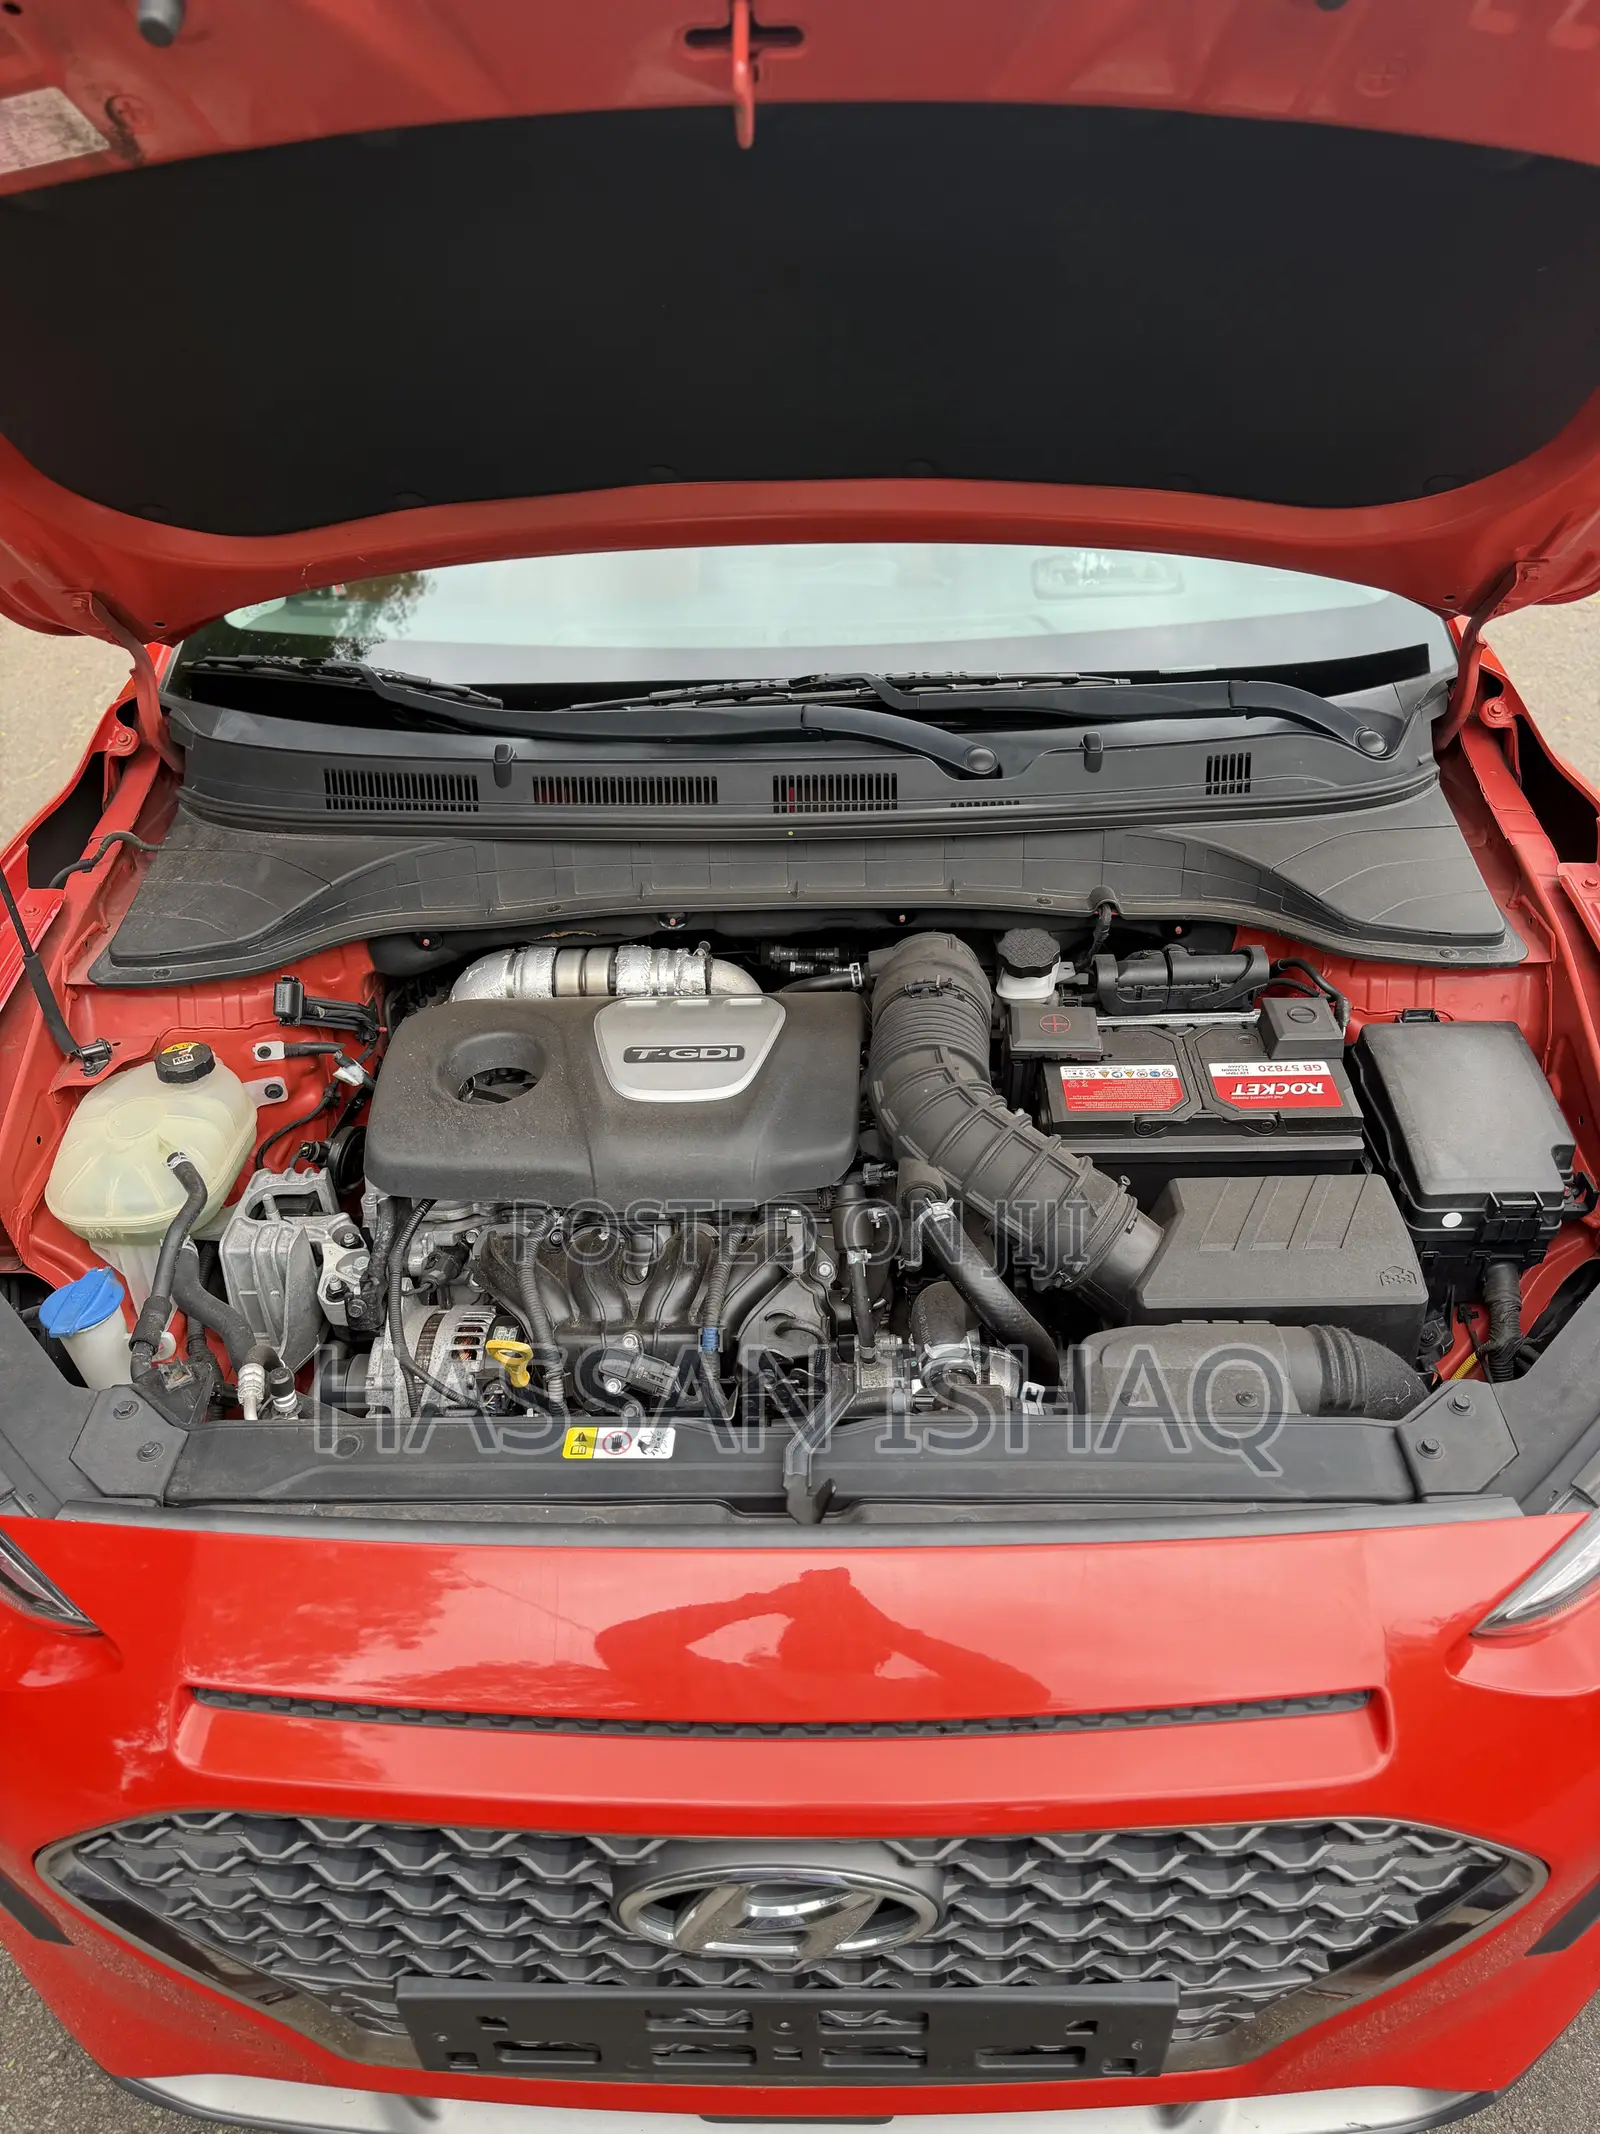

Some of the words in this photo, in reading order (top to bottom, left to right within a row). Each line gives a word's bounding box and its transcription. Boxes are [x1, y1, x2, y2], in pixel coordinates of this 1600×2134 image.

[632, 1047, 738, 1060] T-GDI
[1258, 1064, 1300, 1072] 57820
[1231, 1083, 1324, 1096] ROCKET
